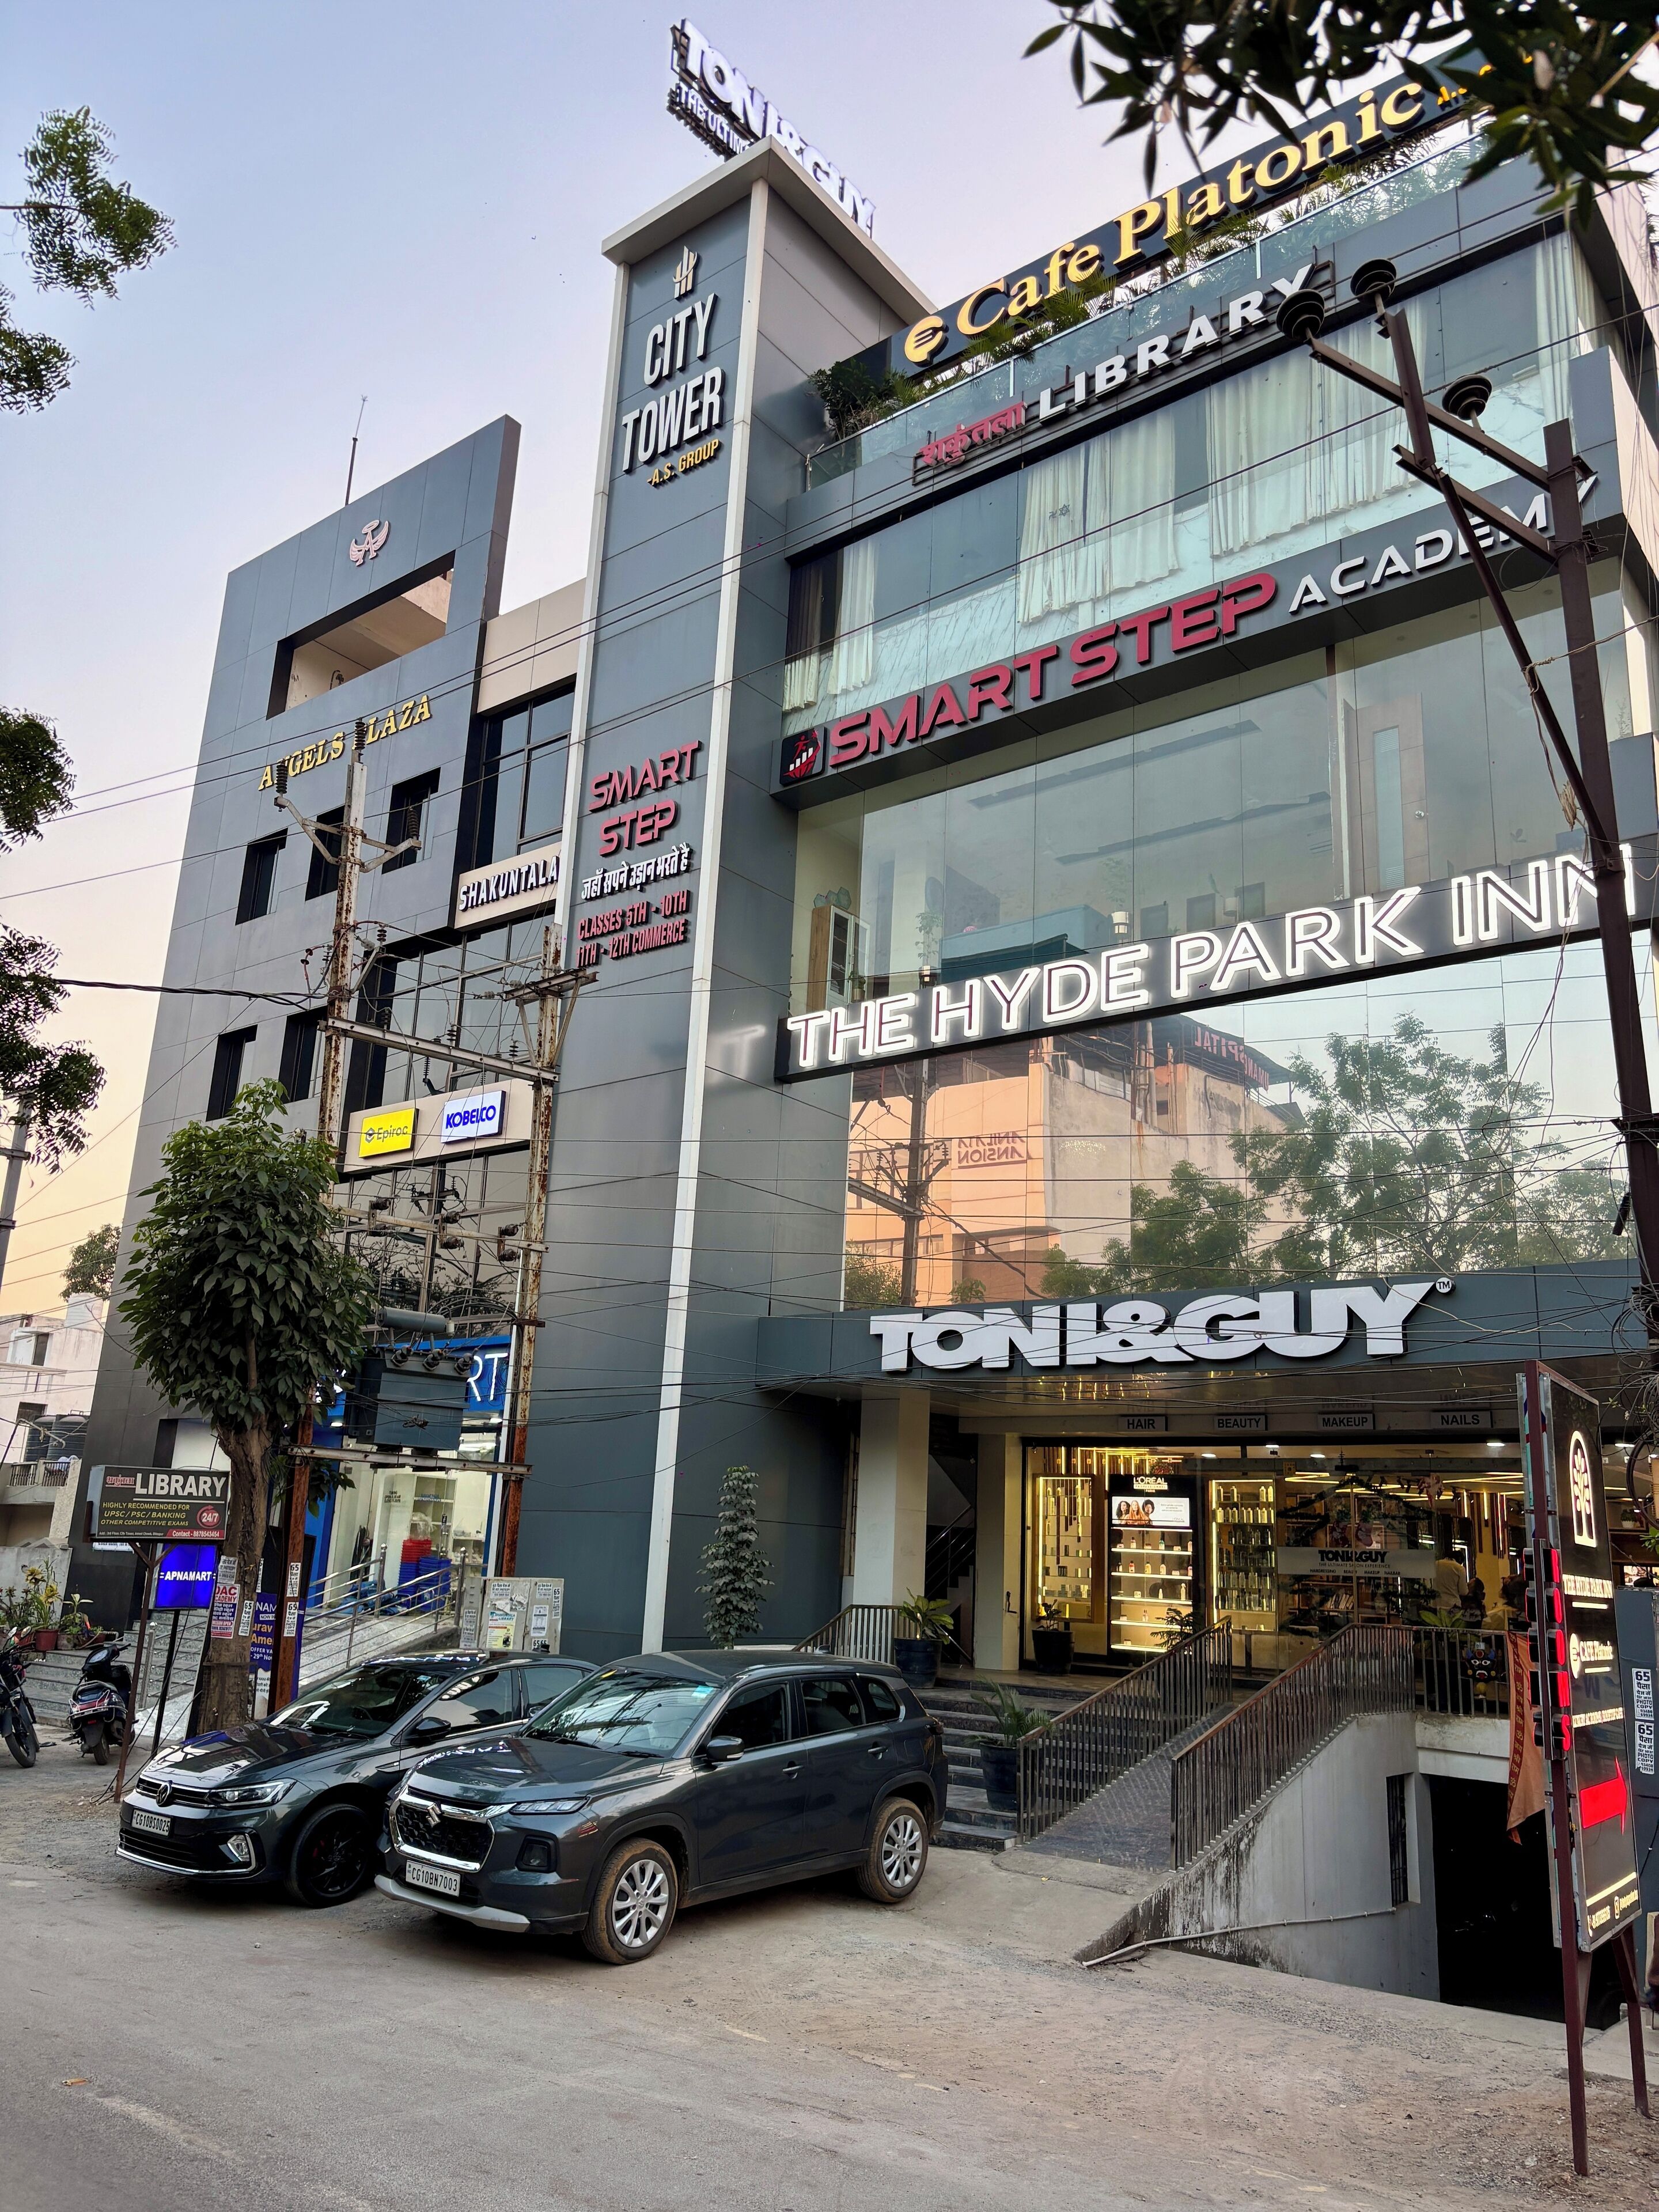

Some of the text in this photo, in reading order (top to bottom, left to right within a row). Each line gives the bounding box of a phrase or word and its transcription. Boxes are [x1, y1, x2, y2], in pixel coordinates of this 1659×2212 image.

[707, 112, 751, 155] ULTIM
[956, 82, 1423, 336] Cafe Platonic
[643, 293, 718, 387] CITY
[920, 263, 1316, 465] शकुंतला LIBRARY
[622, 366, 724, 474] TOWER
[679, 438, 720, 472] GROUP
[830, 645, 1059, 768] SMART
[1070, 573, 1277, 687] STEP
[258, 694, 432, 791] AGELS LAZA
[589, 740, 702, 812] SMART
[599, 798, 677, 857] STEP
[603, 861, 630, 894] सपने
[656, 845, 680, 879] भरते
[680, 842, 691, 871] है
[459, 855, 559, 911] SHAKUNTALA
[577, 908, 623, 941] CLASSES
[626, 899, 650, 926] 5TH
[660, 890, 690, 918] 10TH
[576, 940, 600, 968] 11TH
[608, 932, 632, 960] 12TH
[632, 918, 687, 953] COMMERCE
[787, 843, 1637, 1068] THE HYDE PARK INN
[445, 1105, 497, 1130] KOBELCO
[376, 1125, 408, 1142] Epiroc
[869, 1282, 1435, 1373] TONI&GUY
[1127, 1418, 1156, 1431] HAIR
[1217, 1418, 1262, 1429] BEAUTY
[1323, 1416, 1369, 1428] MAKEUP
[1441, 1414, 1480, 1426] NAILS
[135, 1473, 226, 1497] LIBRARY
[202, 1513, 219, 1522] 24/7
[1318, 1550, 1390, 1563] TONI&GUY
[164, 1571, 213, 1581] APNAMART
[1635, 1671, 1650, 1682] 65
[1637, 1681, 1650, 1690] पैसा
[1638, 1724, 1653, 1736] 65
[1638, 1734, 1653, 1744] पैसा
[135, 1813, 170, 1833] CG10BS0025
[412, 1867, 457, 1892] CG10BN7003
